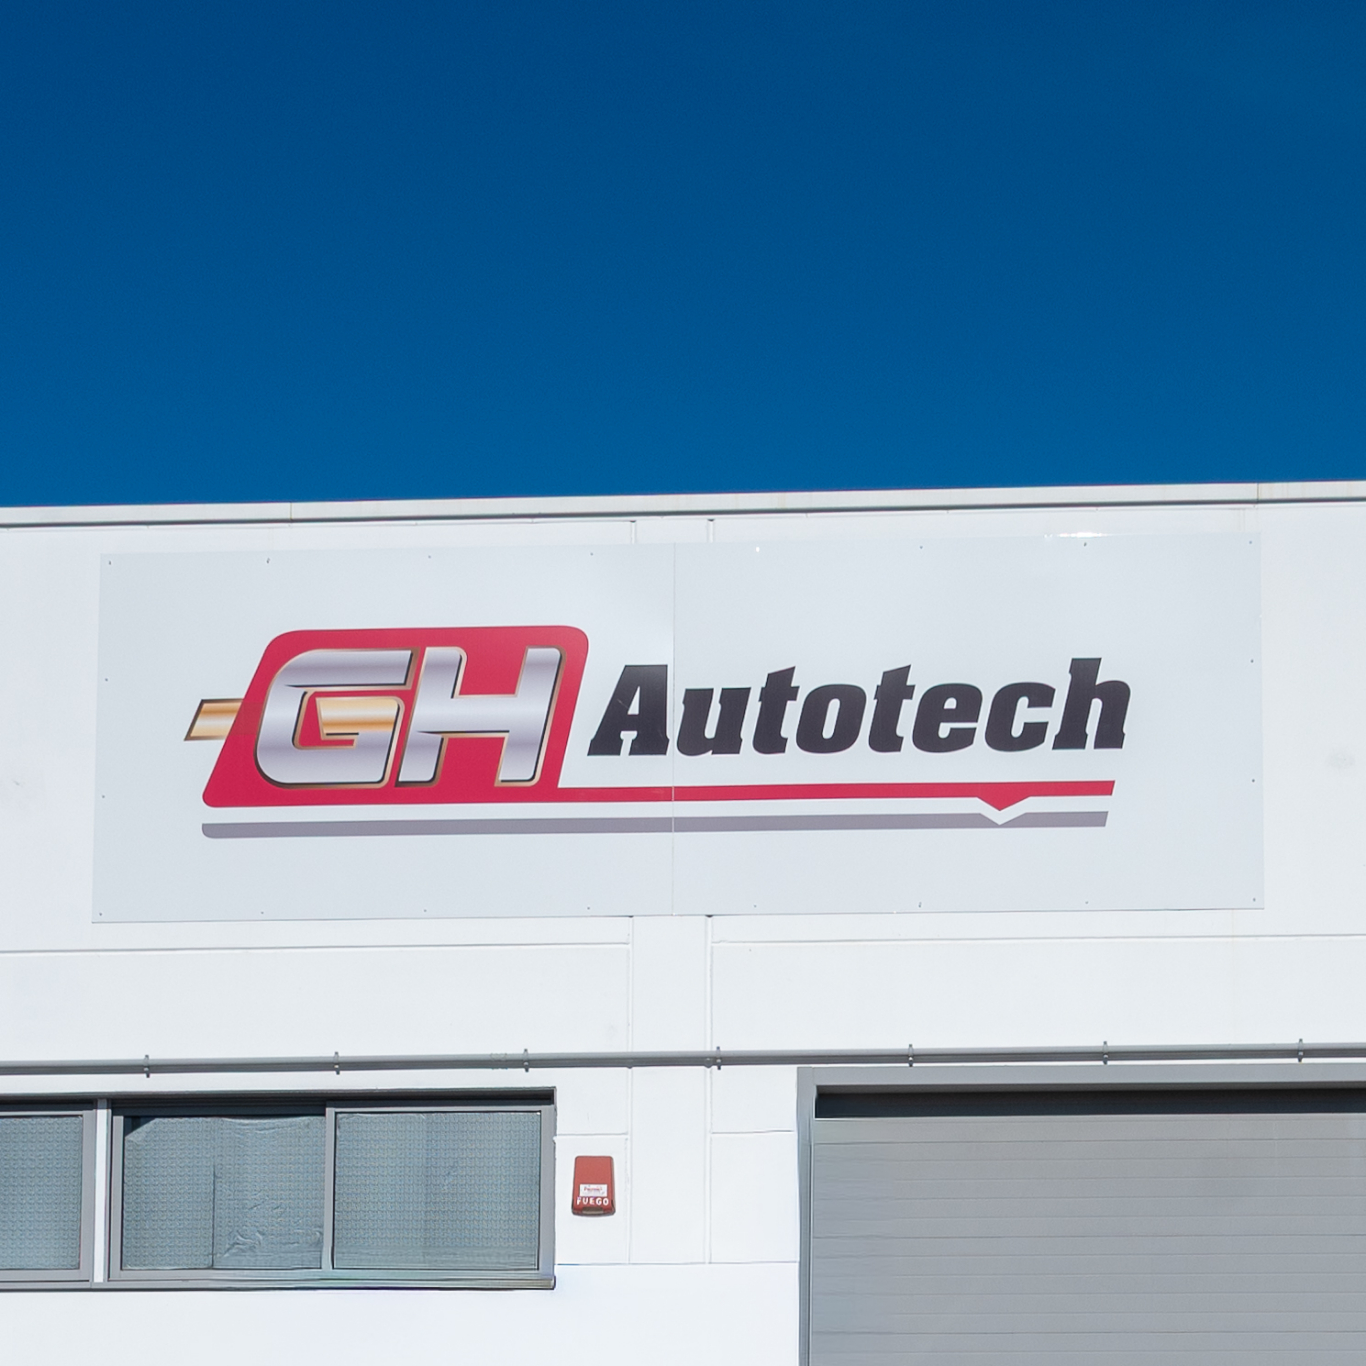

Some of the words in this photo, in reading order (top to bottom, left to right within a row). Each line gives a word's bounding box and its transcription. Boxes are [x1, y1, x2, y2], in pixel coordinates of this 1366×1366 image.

[252, 645, 568, 789] GH
[587, 657, 1131, 758] Autotech
[576, 1197, 609, 1206] FUEGO
